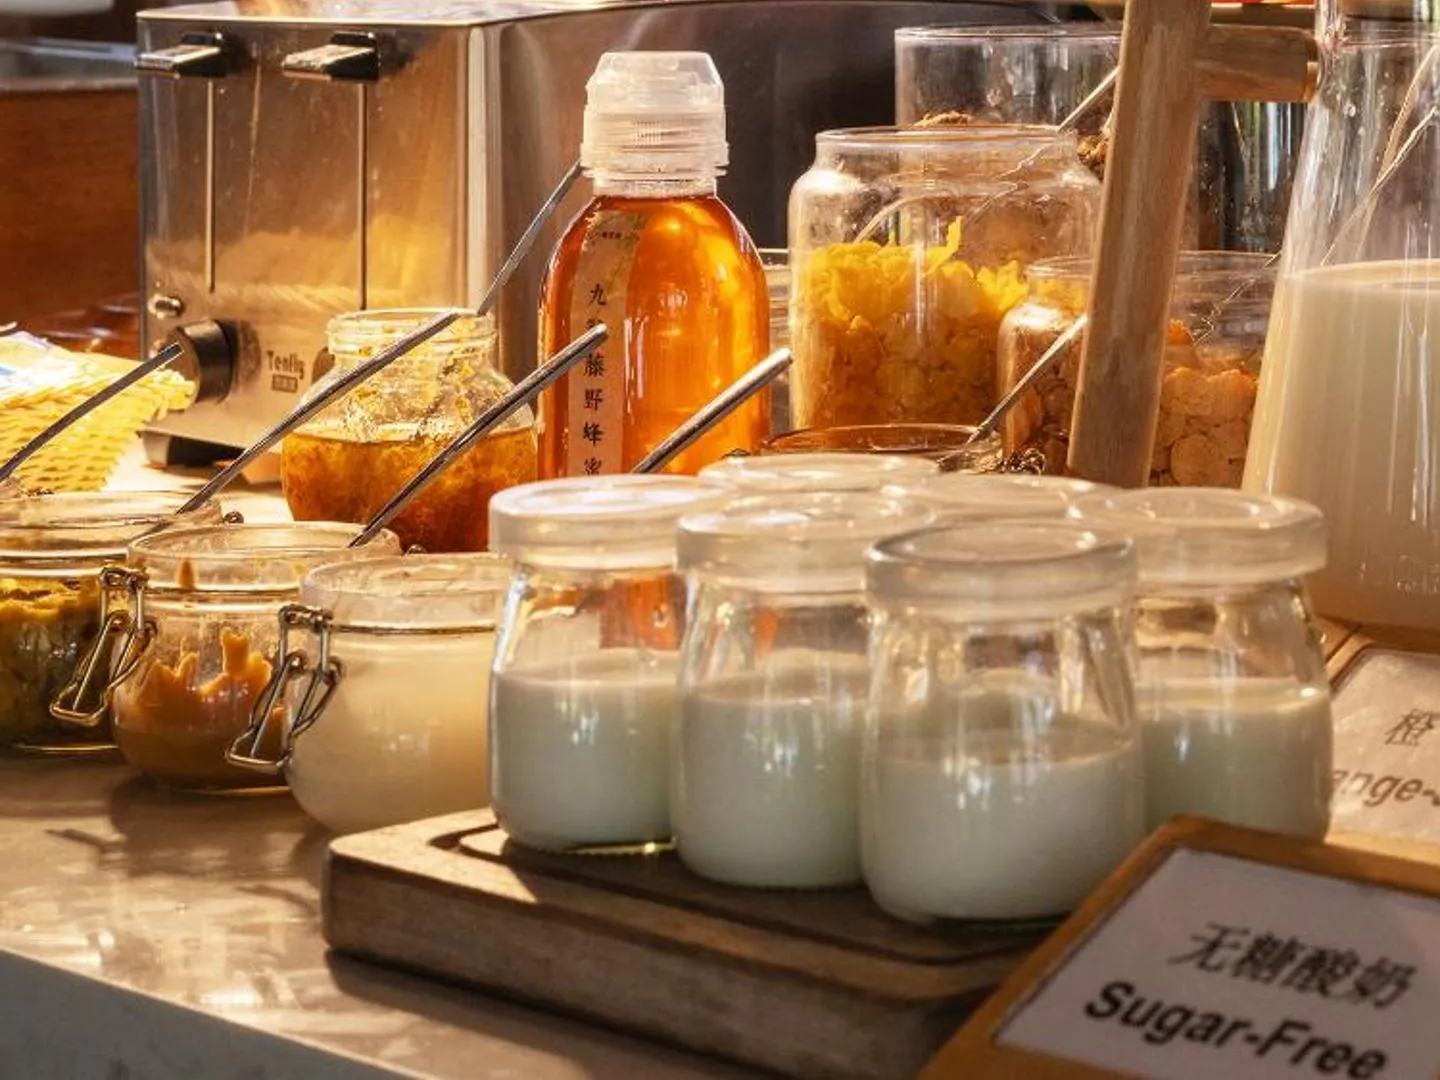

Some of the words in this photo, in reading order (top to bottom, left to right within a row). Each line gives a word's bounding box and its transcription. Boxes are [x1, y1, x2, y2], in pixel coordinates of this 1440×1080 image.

[583, 283, 608, 475] 九藤野蜂蜜
[1170, 922, 1416, 1008] 无糖酸奶
[1084, 980, 1389, 1080] Sugar-Free
